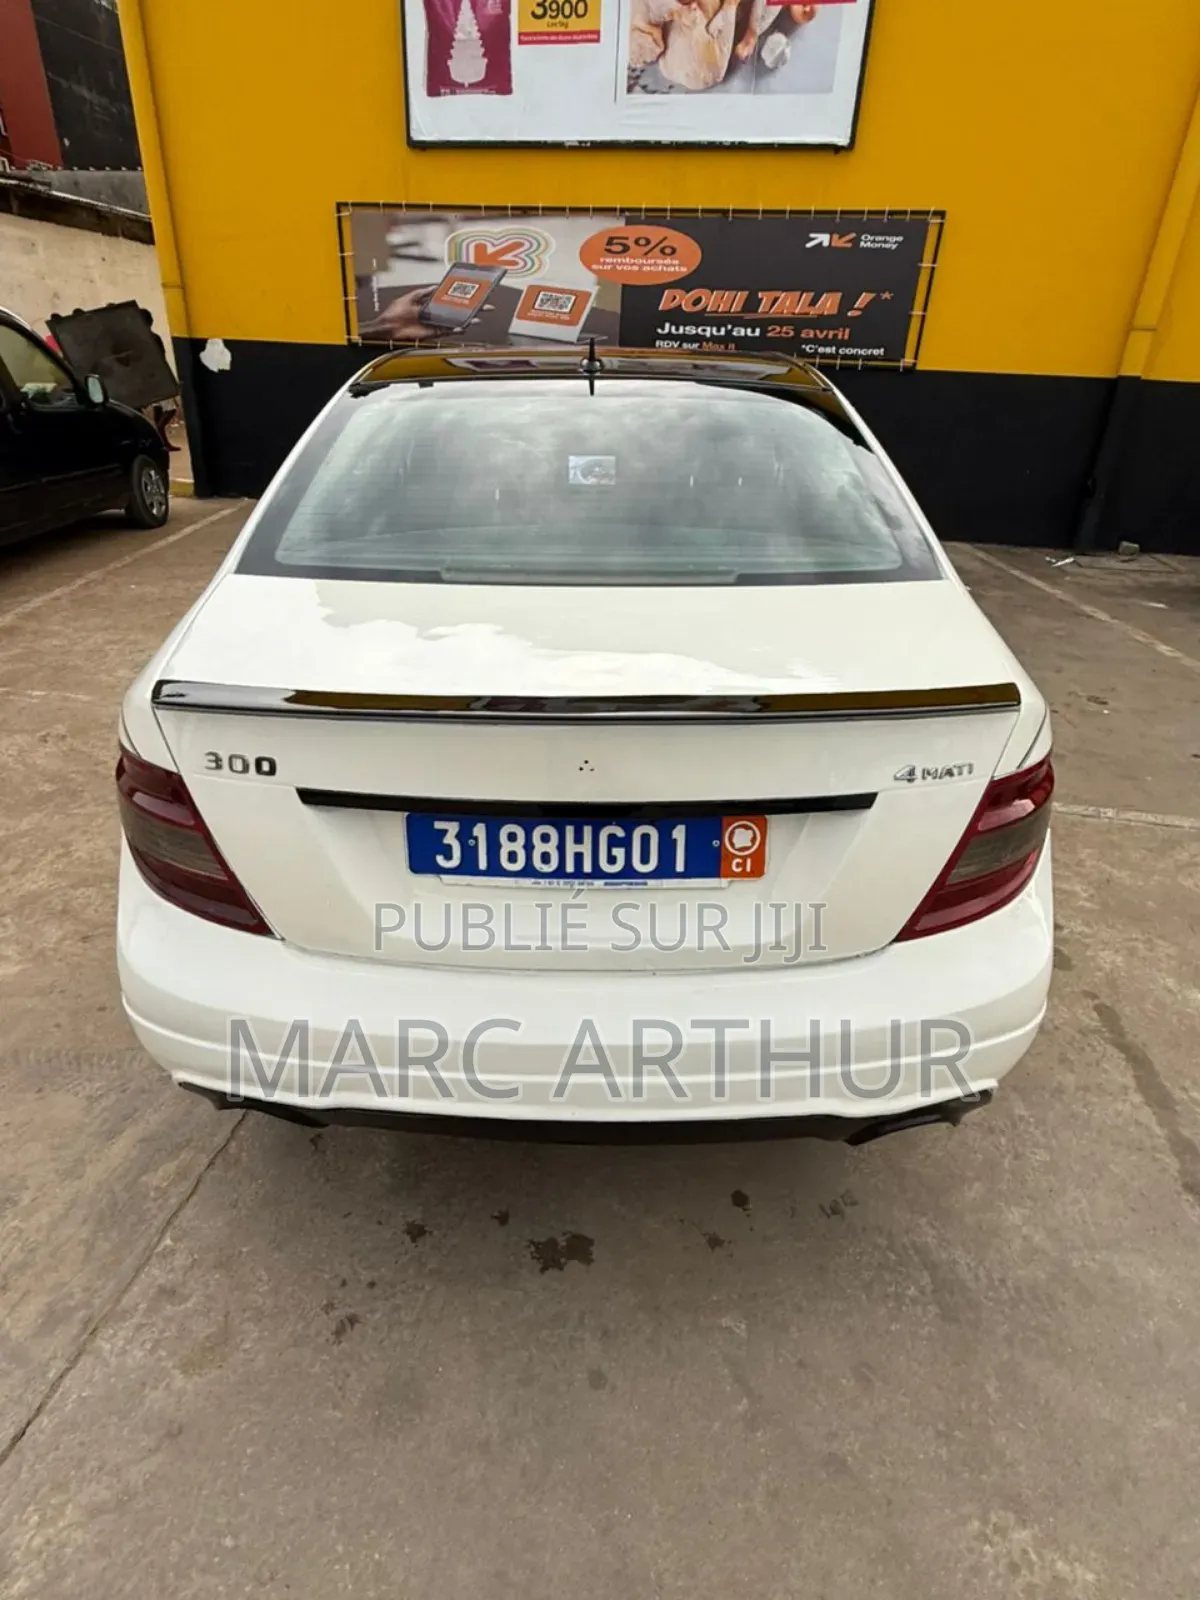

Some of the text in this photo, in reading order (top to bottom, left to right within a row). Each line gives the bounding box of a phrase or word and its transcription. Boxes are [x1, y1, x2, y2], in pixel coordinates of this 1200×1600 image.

[859, 241, 899, 250] Money
[861, 233, 904, 243] Orange
[604, 236, 677, 256] 5%
[643, 264, 688, 272] achats
[659, 288, 749, 313] DOHI
[758, 290, 842, 316] TALA
[656, 322, 850, 340] Jusqu'au 25 avril
[655, 340, 680, 348] RDV
[682, 342, 700, 350] sur
[838, 347, 885, 356] concret
[204, 751, 277, 776] 300
[433, 820, 686, 874] 3188HG01
[731, 858, 752, 873] CI
